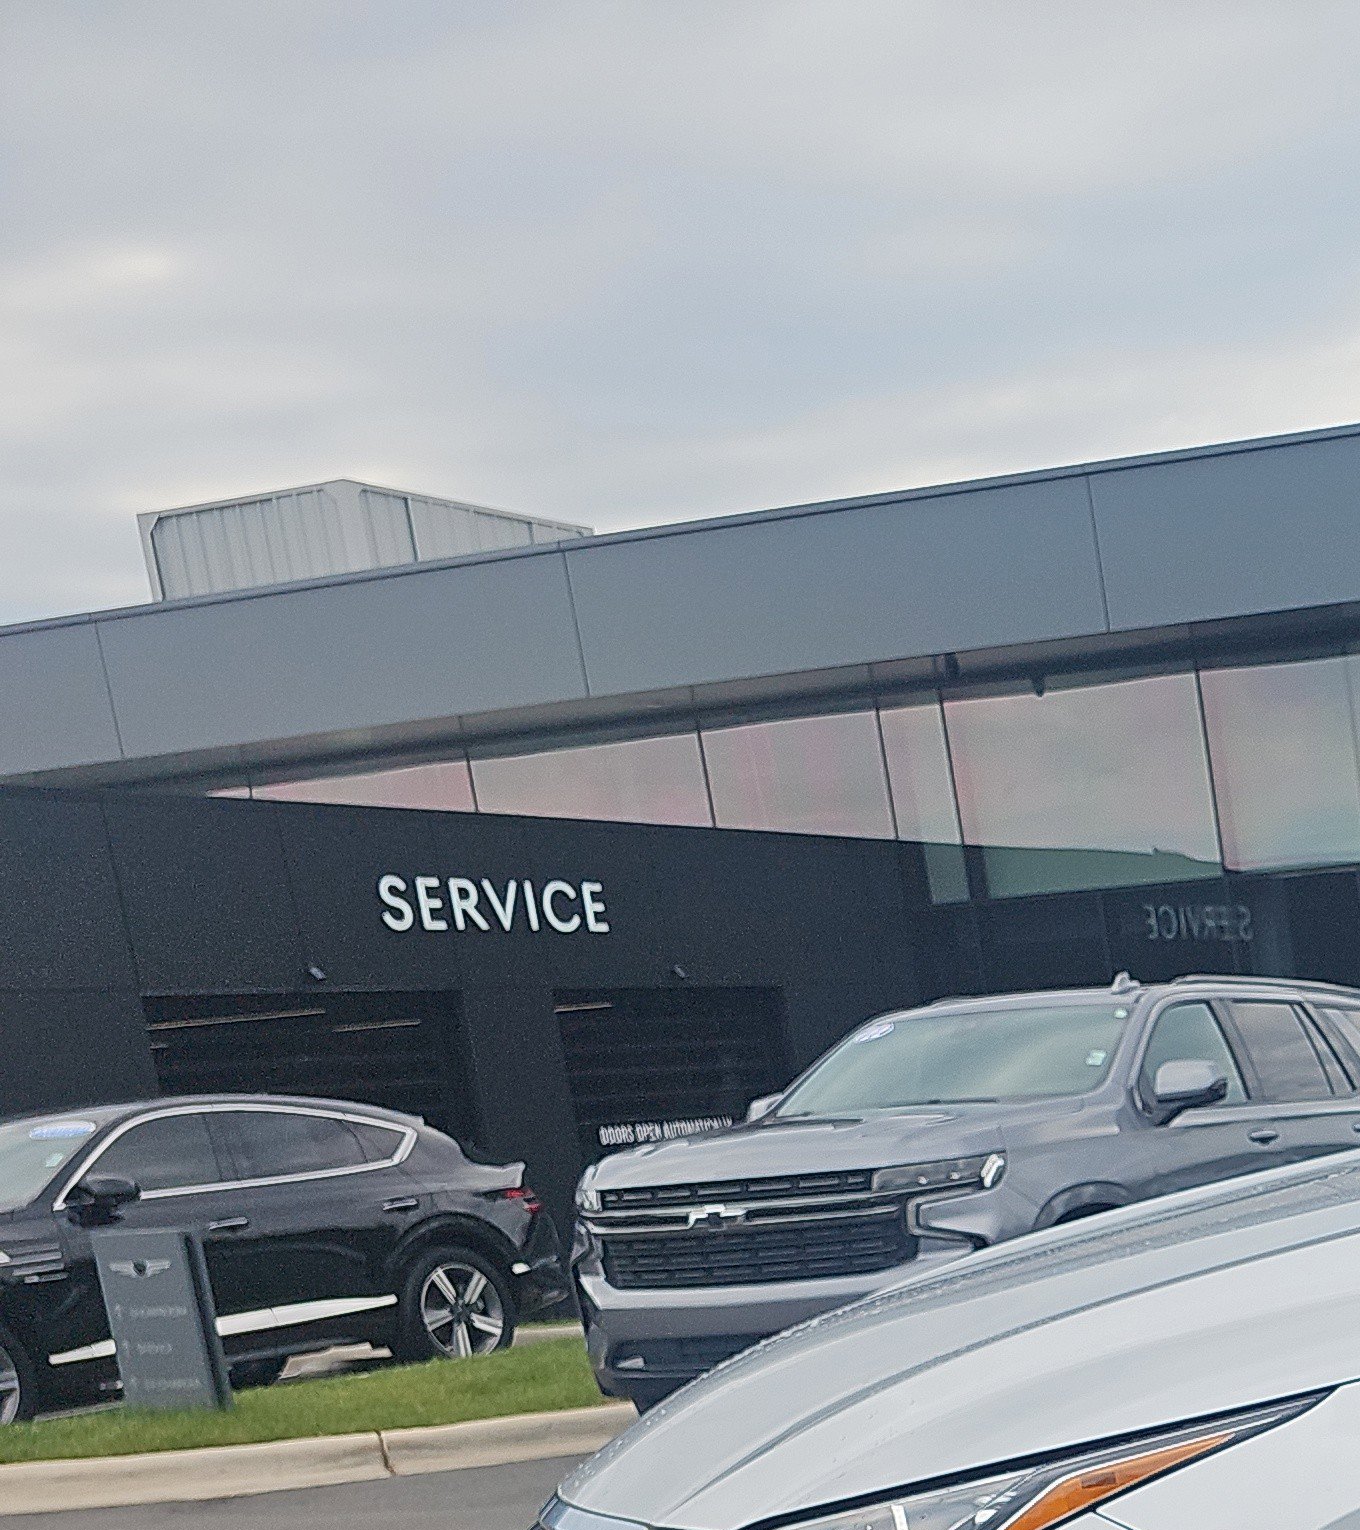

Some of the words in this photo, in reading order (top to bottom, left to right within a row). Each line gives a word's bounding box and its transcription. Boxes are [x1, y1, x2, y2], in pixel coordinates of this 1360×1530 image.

[378, 874, 611, 934] SERVICE
[599, 1124, 635, 1146] DOORS
[636, 1121, 662, 1142] OPEN
